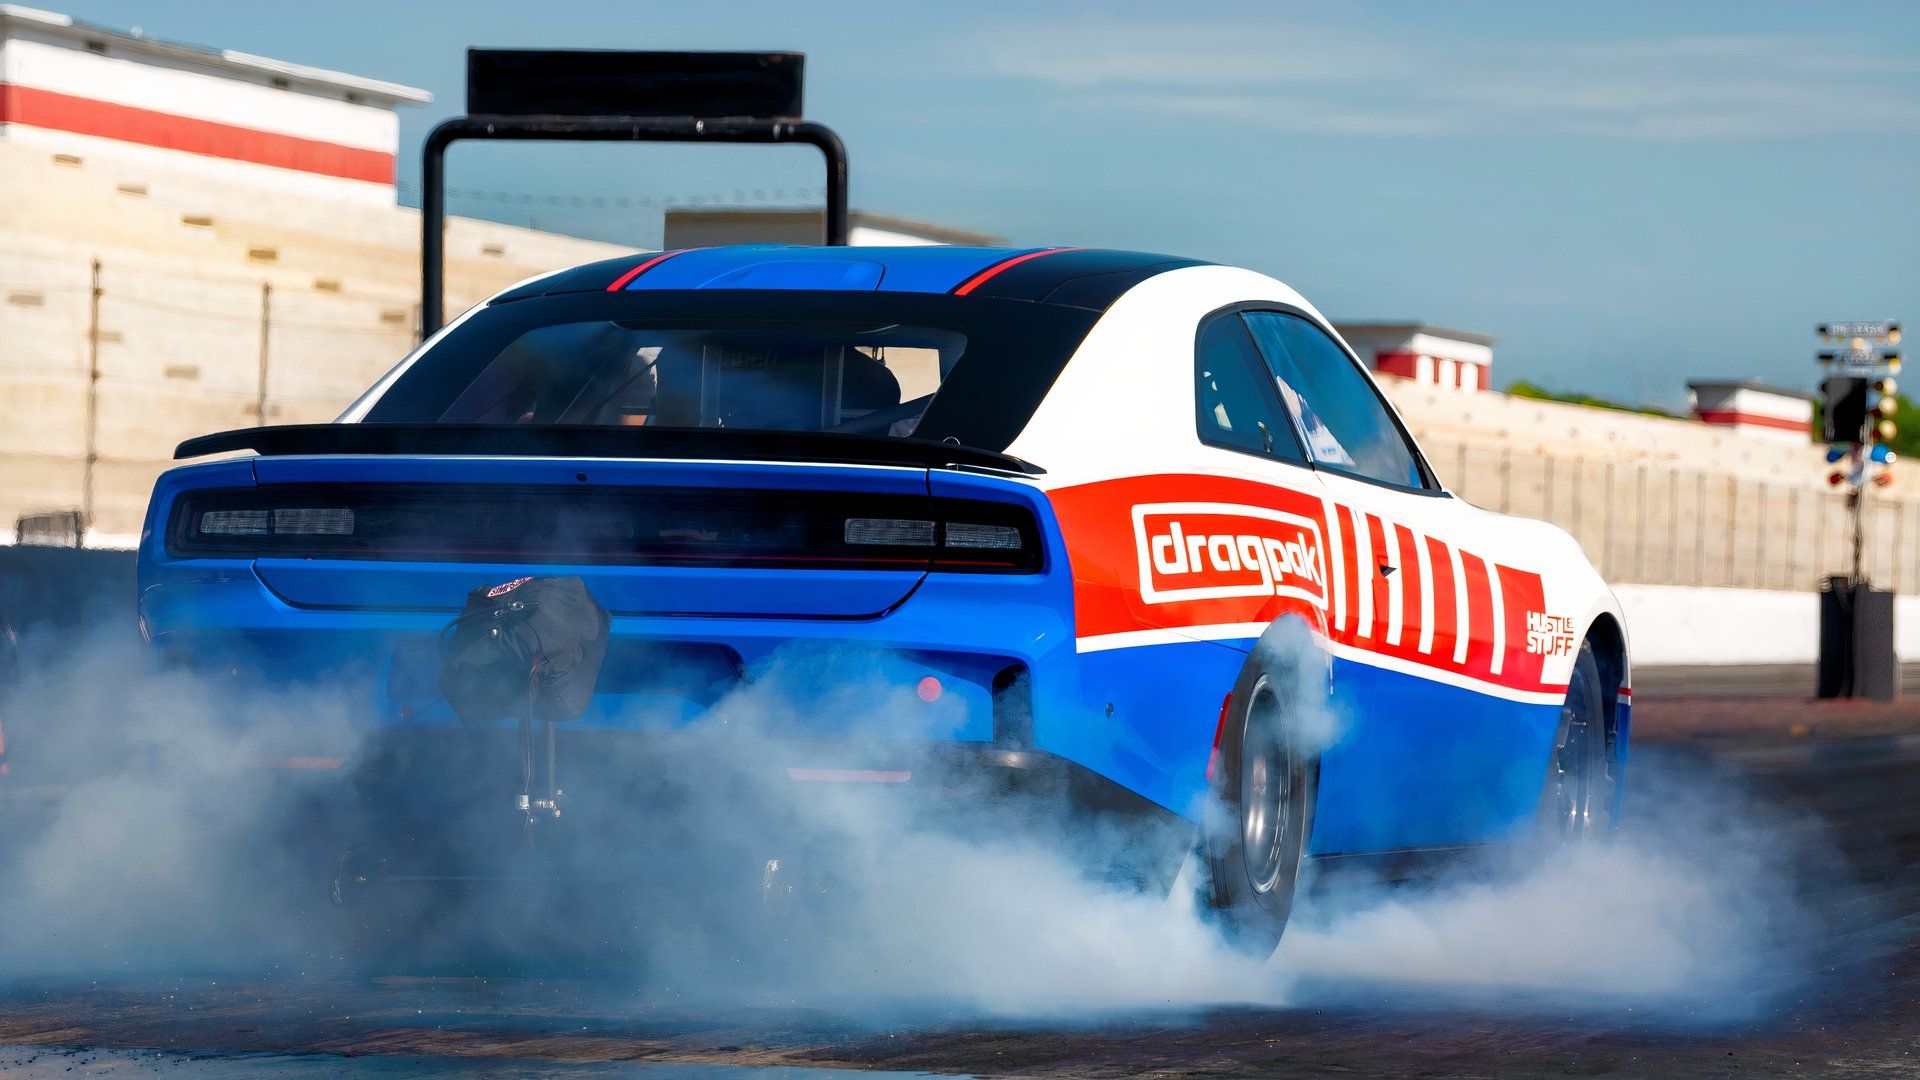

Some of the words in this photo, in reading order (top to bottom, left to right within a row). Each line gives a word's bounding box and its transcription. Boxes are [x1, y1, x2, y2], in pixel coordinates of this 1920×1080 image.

[1151, 521, 1322, 595] dragpak
[1526, 610, 1574, 634] HUSTLE
[1526, 631, 1574, 657] STUFF
